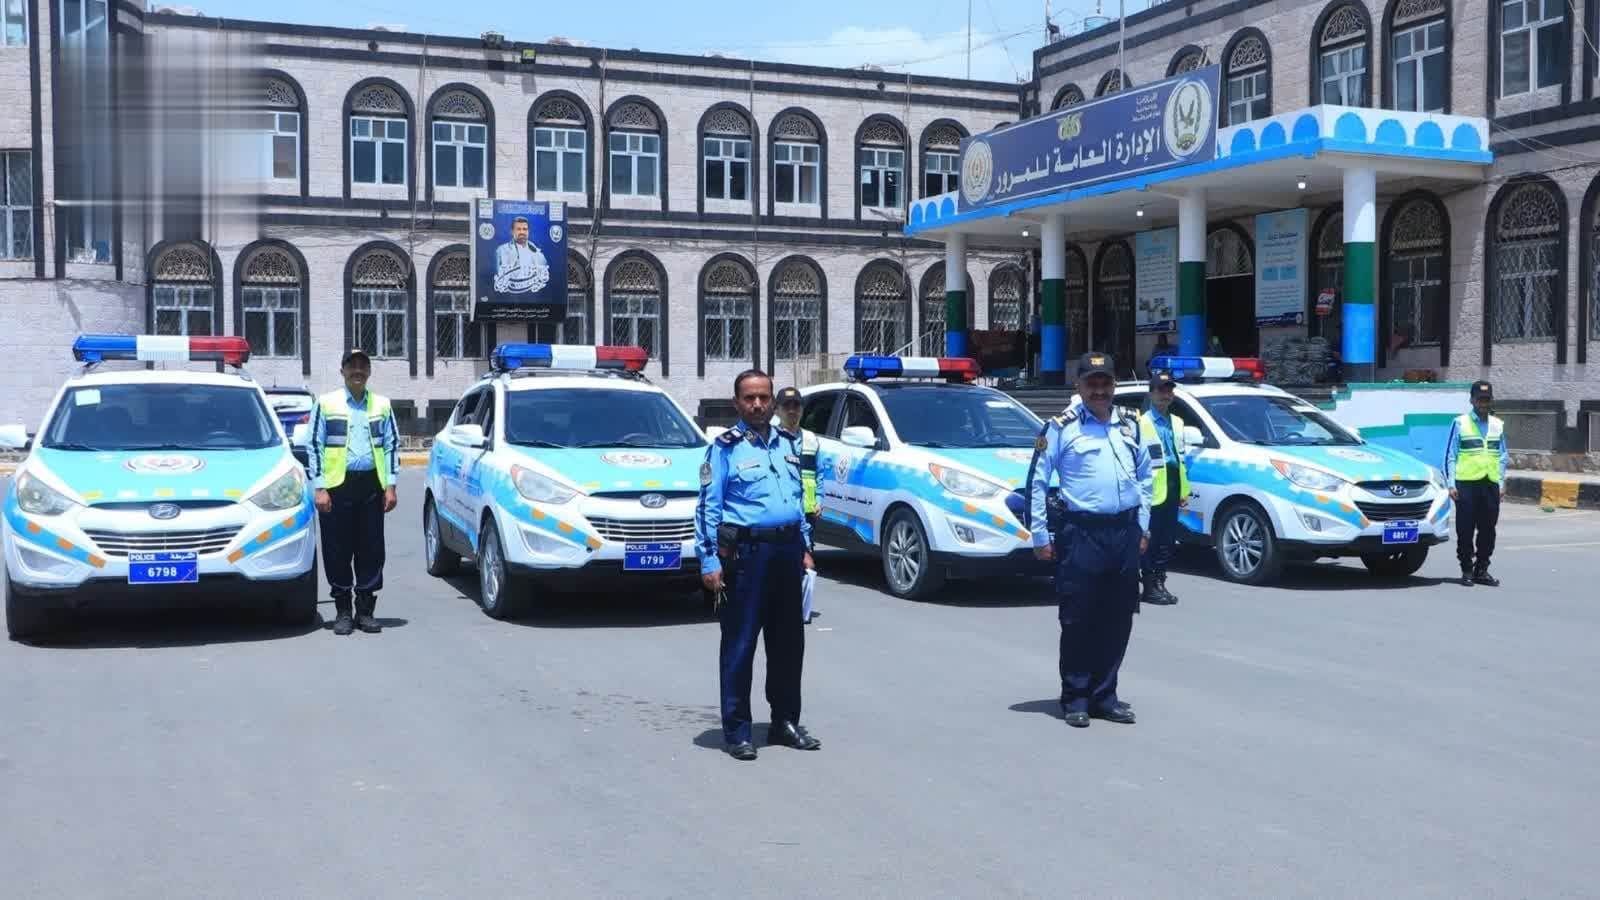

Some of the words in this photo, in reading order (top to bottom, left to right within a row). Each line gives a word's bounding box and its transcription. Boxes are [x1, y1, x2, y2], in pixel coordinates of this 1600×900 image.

[1054, 138, 1112, 173] العامة
[1116, 127, 1160, 164] الإدارة
[995, 153, 1050, 193] للمرور
[130, 553, 155, 561] POLICE
[640, 556, 664, 565] 6799
[147, 566, 177, 577] 6798
